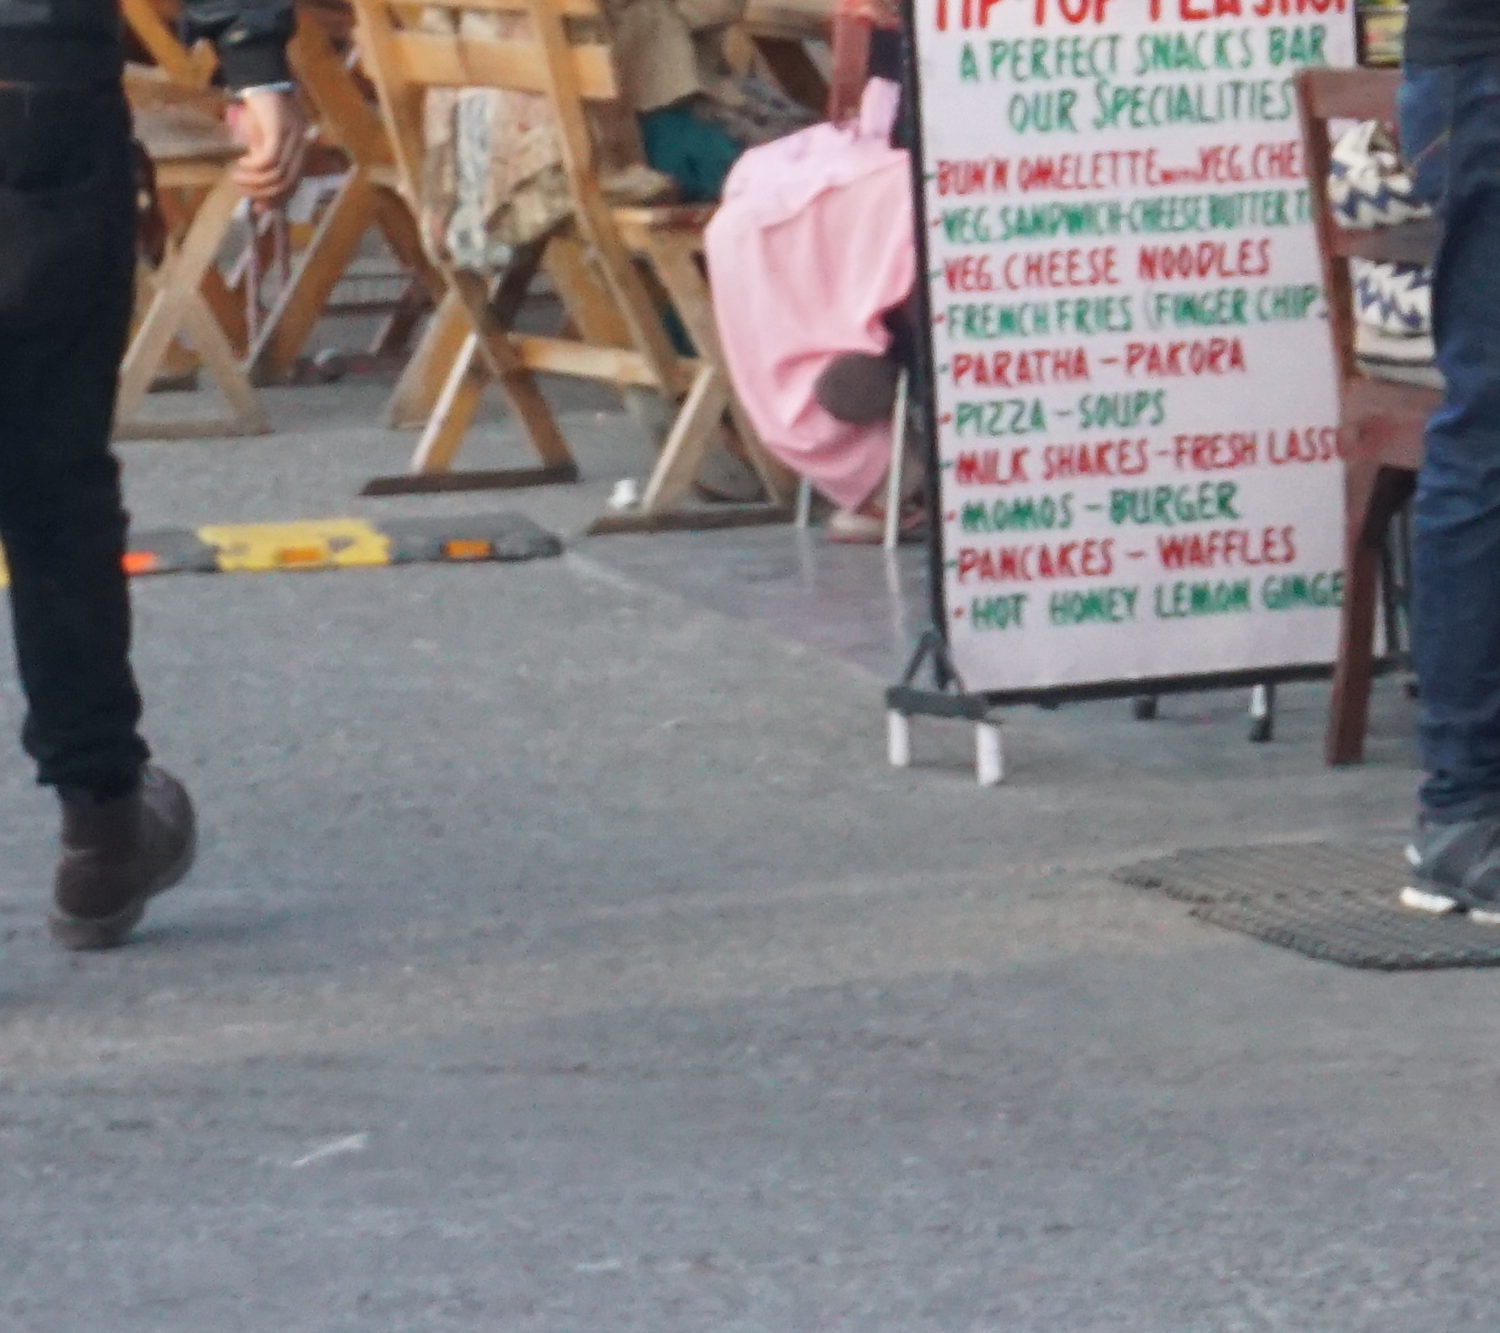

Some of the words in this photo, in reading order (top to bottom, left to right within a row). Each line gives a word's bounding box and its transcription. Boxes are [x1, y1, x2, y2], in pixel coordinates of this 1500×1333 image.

[958, 41, 978, 81] A
[989, 34, 1119, 82] PERFECT
[1136, 27, 1252, 76] SNACKS
[1268, 24, 1328, 66] BAR
[1008, 88, 1079, 132] OUR
[1093, 78, 1296, 131] SPECIALITIES
[1017, 148, 1160, 193] OMELETTE
[1198, 144, 1241, 184] VEG
[1252, 140, 1304, 180] CHE
[944, 204, 990, 242] VEG
[944, 254, 994, 292] VEG
[1003, 245, 1122, 291] CHEESE
[1137, 238, 1272, 282] NOODLES
[947, 303, 1050, 341] FRENCH
[1055, 295, 1134, 333] FRIES
[951, 346, 1090, 389] PARATHA
[1124, 336, 1248, 378] PAKORA
[955, 397, 1047, 437] PIZZA
[1077, 388, 1167, 430] SOUPS
[955, 446, 1030, 486] MILK
[1042, 438, 1149, 481] SHAKES
[1174, 432, 1258, 471] FRESH
[959, 491, 1075, 532] MOMOS
[1110, 479, 1241, 527] BURGER
[956, 537, 1114, 584] PANCAKES
[1157, 525, 1297, 570] WAFFLES
[971, 592, 1030, 630] HOT
[1048, 584, 1140, 628] HONEY
[1153, 577, 1252, 619] LEMON
